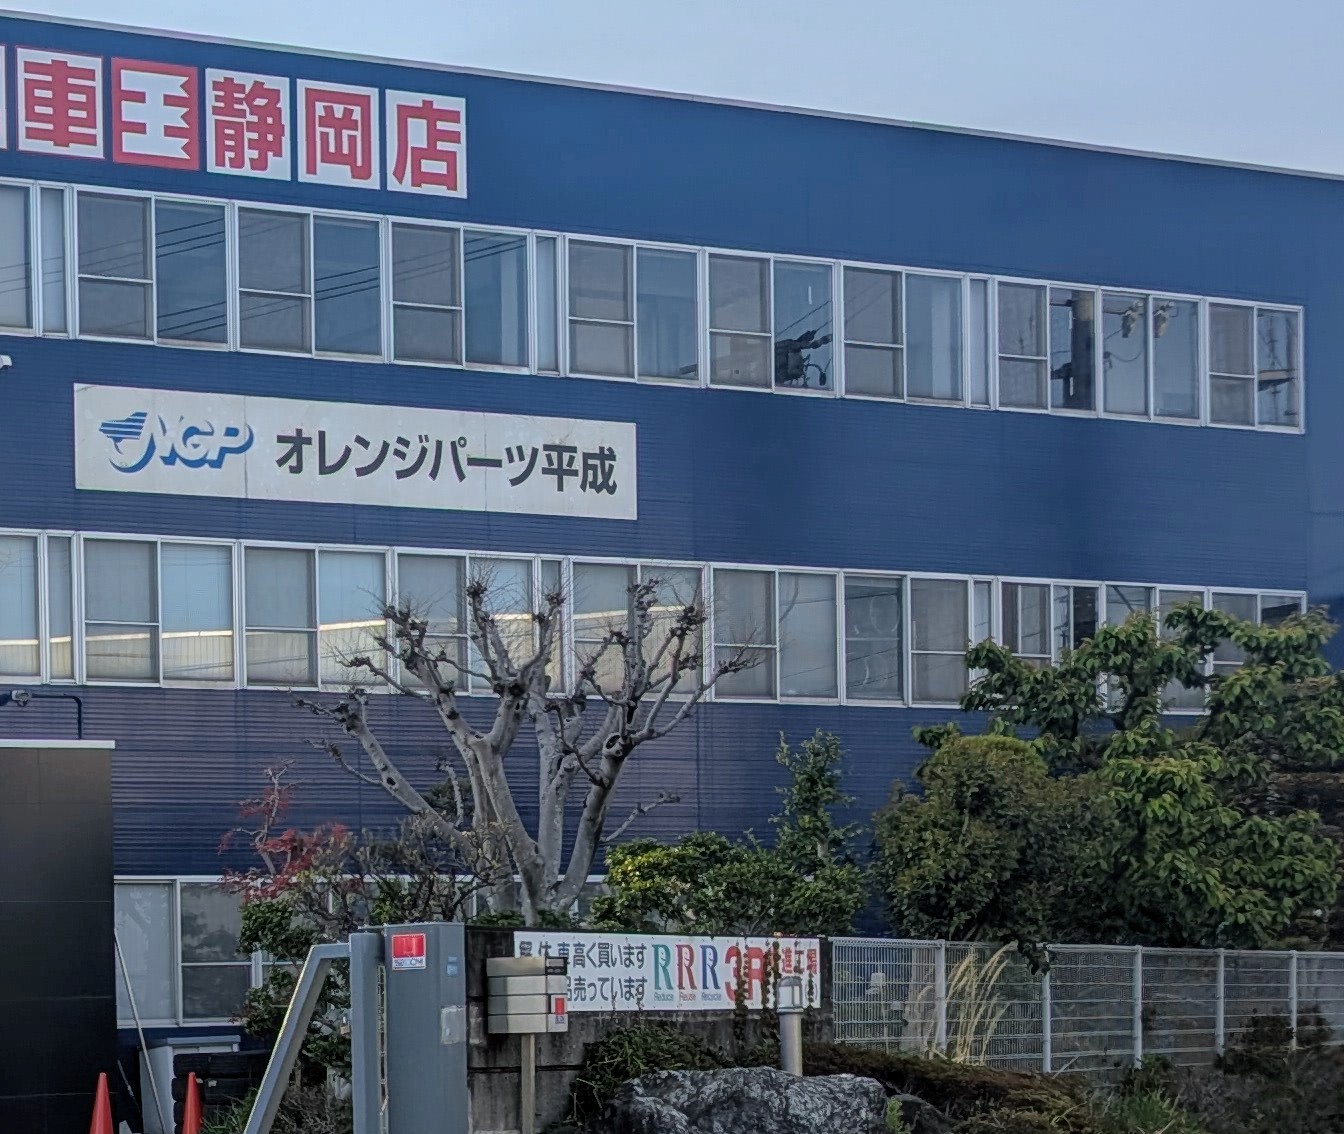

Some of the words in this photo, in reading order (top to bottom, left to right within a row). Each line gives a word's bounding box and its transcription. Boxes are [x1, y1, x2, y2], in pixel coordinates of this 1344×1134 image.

[275, 428, 618, 496] オレンジパーツ平成
